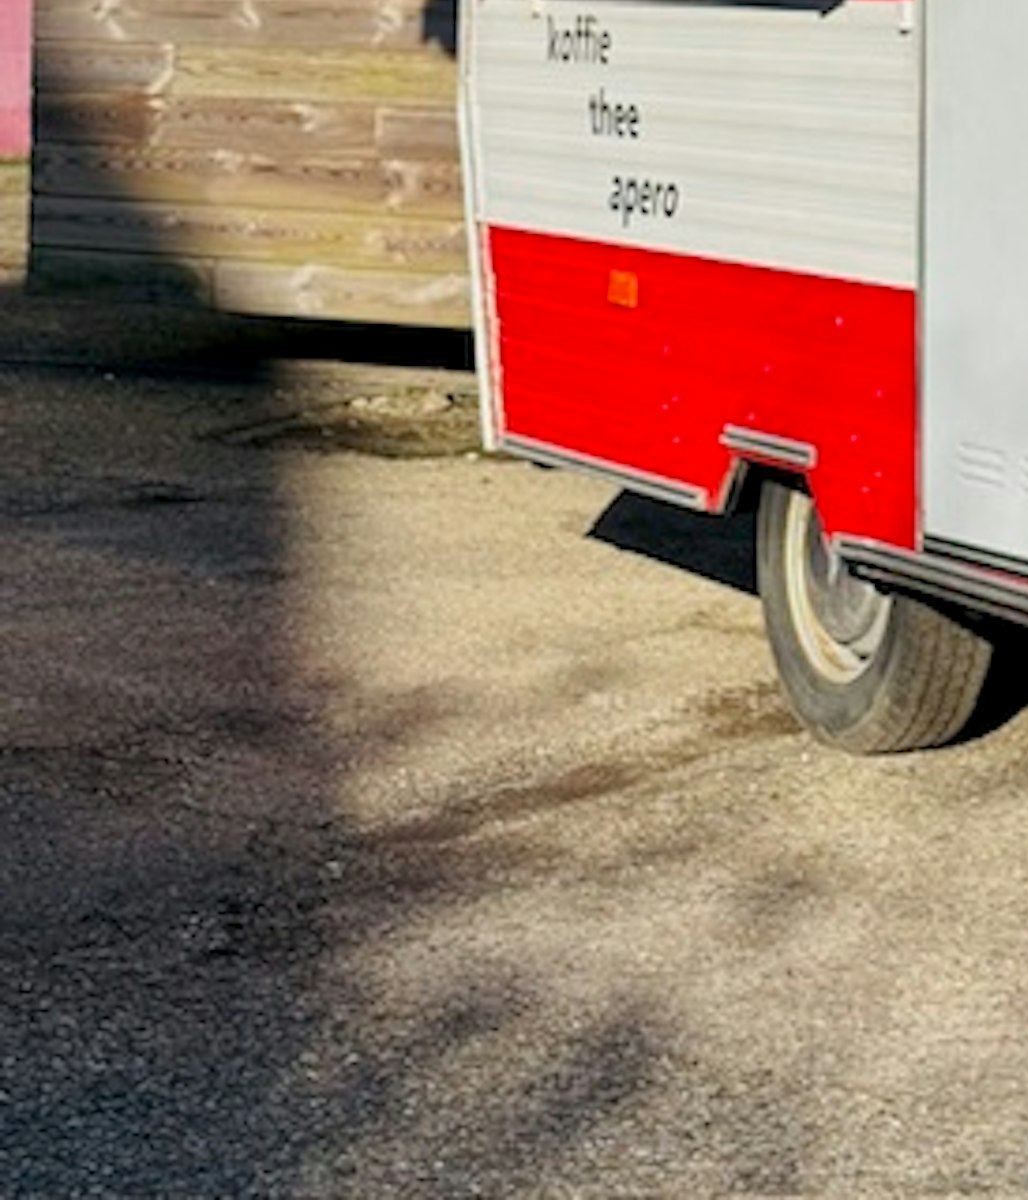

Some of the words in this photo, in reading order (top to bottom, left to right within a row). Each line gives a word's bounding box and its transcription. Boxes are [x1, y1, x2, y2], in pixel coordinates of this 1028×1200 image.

[547, 14, 611, 63] koffie
[588, 86, 640, 138] thee
[608, 176, 679, 228] apero
